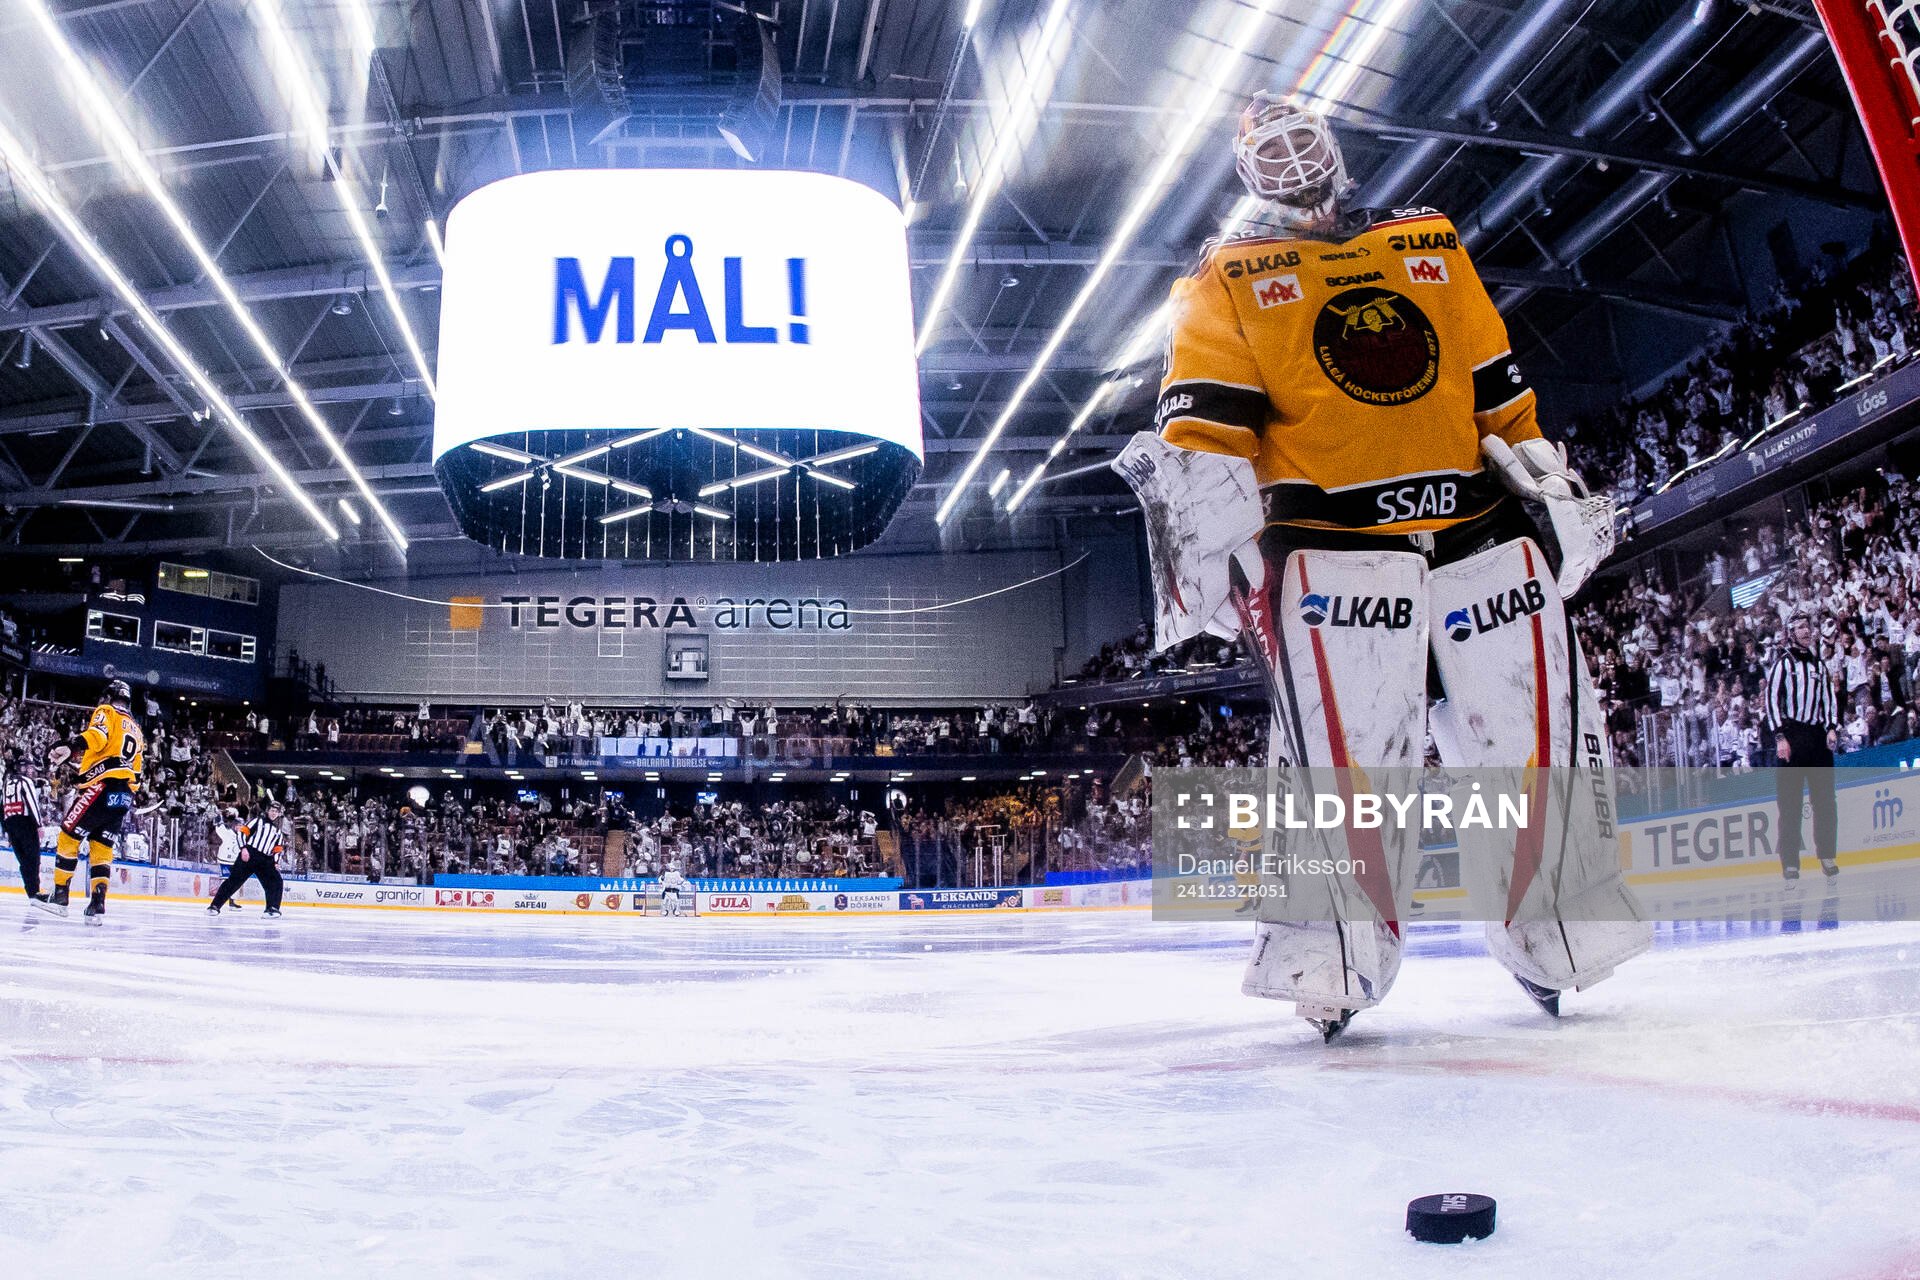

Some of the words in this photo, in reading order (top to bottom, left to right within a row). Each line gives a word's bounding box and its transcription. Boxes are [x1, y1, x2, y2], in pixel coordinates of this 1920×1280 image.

[1391, 206, 1438, 218] SSA
[1408, 232, 1458, 250] LKAB
[1245, 250, 1302, 275] LKAB
[1410, 259, 1445, 282] MAX
[1324, 271, 1385, 287] SCANIA
[551, 234, 811, 345] MÅL!
[1259, 280, 1300, 306] MAX
[1376, 482, 1457, 524] SSAB
[714, 597, 853, 630] arena
[1330, 595, 1413, 629] LKAB
[1471, 578, 1546, 634] LKAB
[85, 764, 106, 781] SSAB
[1584, 733, 1613, 839] BAUER
[375, 888, 423, 903] granitor
[514, 901, 547, 909] SAFE4U
[711, 897, 750, 909] JULA
[850, 900, 883, 909] DÖRREN
[931, 891, 998, 902] LEKSANDS
